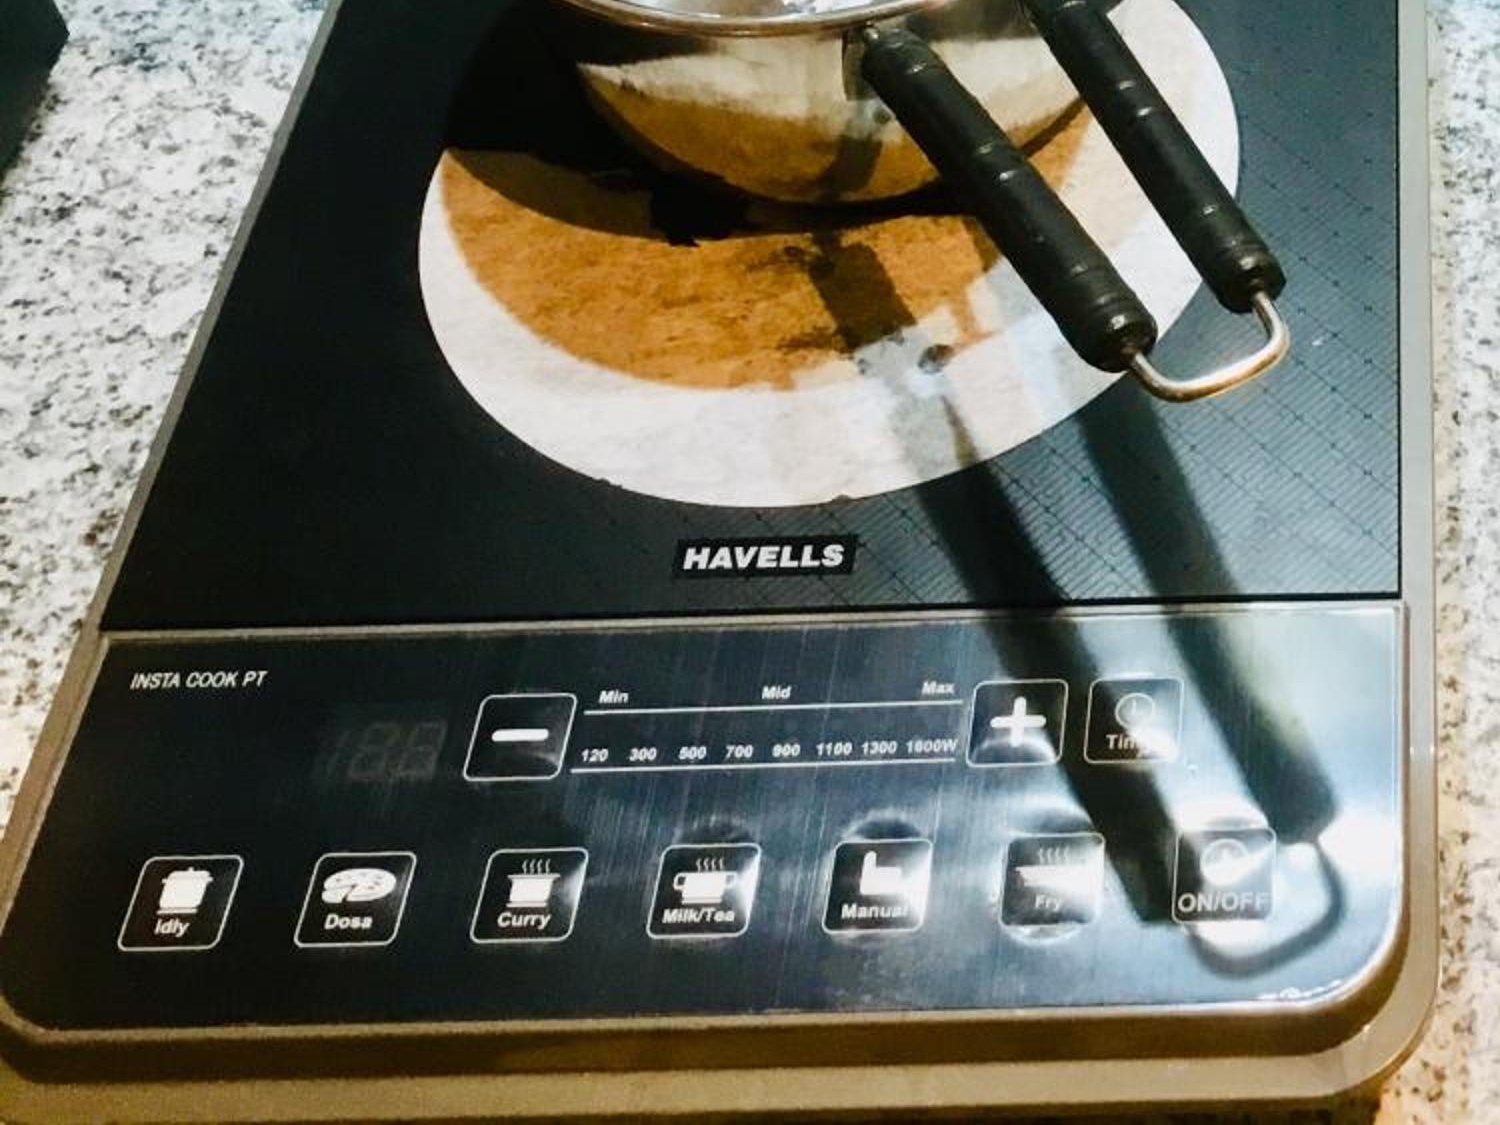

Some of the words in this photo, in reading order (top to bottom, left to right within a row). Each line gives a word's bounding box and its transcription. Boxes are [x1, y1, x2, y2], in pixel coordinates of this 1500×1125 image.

[682, 544, 845, 570] HAVELLS
[129, 671, 181, 690] INSTA
[185, 671, 238, 688] COOK
[242, 670, 268, 687] PT
[599, 690, 629, 704] Min
[761, 685, 792, 700] Mid
[921, 681, 955, 695] Max
[580, 748, 609, 763] 120
[629, 747, 657, 762] 300
[725, 744, 754, 759] 700
[815, 742, 852, 756] 1100
[861, 741, 897, 755] 1300
[1034, 894, 1062, 912] Fry
[1176, 891, 1267, 913] ON/OFF
[324, 914, 373, 931] Dosa
[497, 911, 551, 931] Curry
[662, 906, 735, 924] Milk/Tea
[154, 919, 190, 939] Idly
